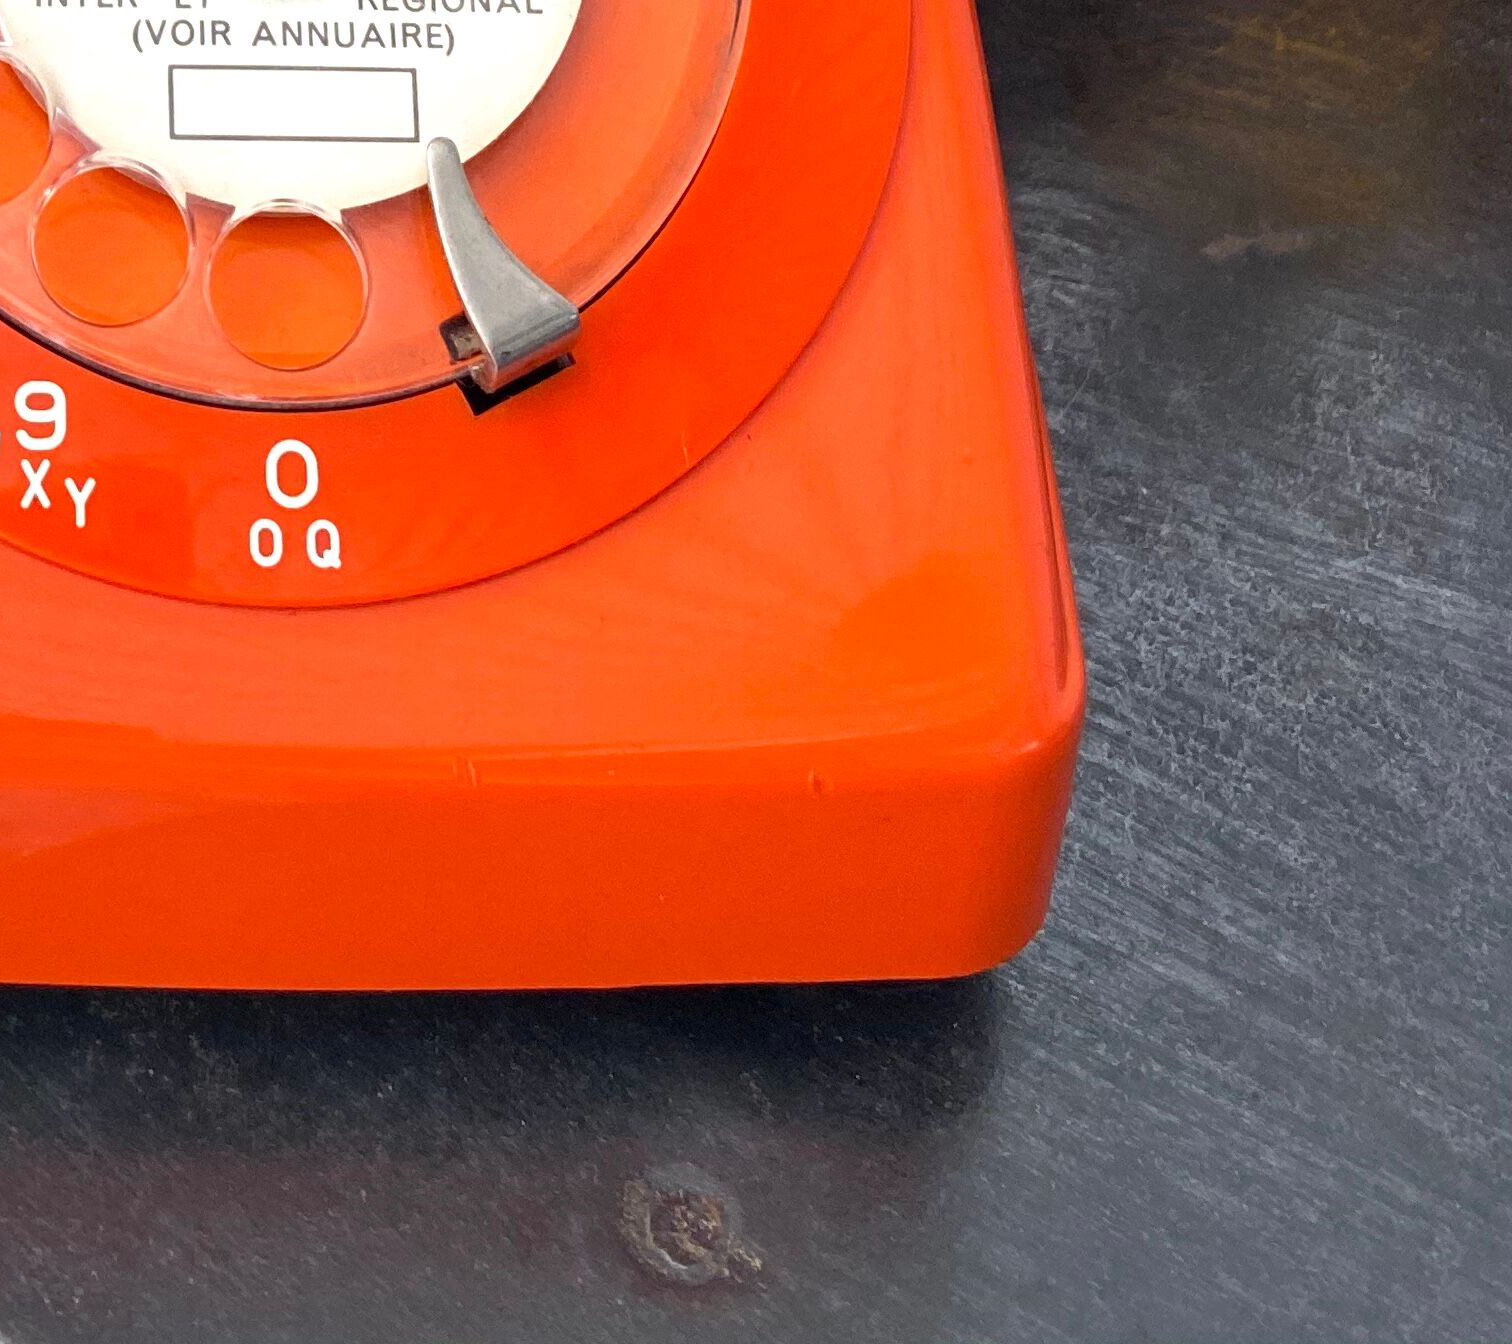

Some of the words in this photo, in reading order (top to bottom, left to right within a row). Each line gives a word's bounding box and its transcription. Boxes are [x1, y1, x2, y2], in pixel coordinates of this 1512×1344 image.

[131, 17, 232, 53] (VOIR
[251, 20, 456, 57] ANNUAIRE)
[12, 379, 68, 453] 9
